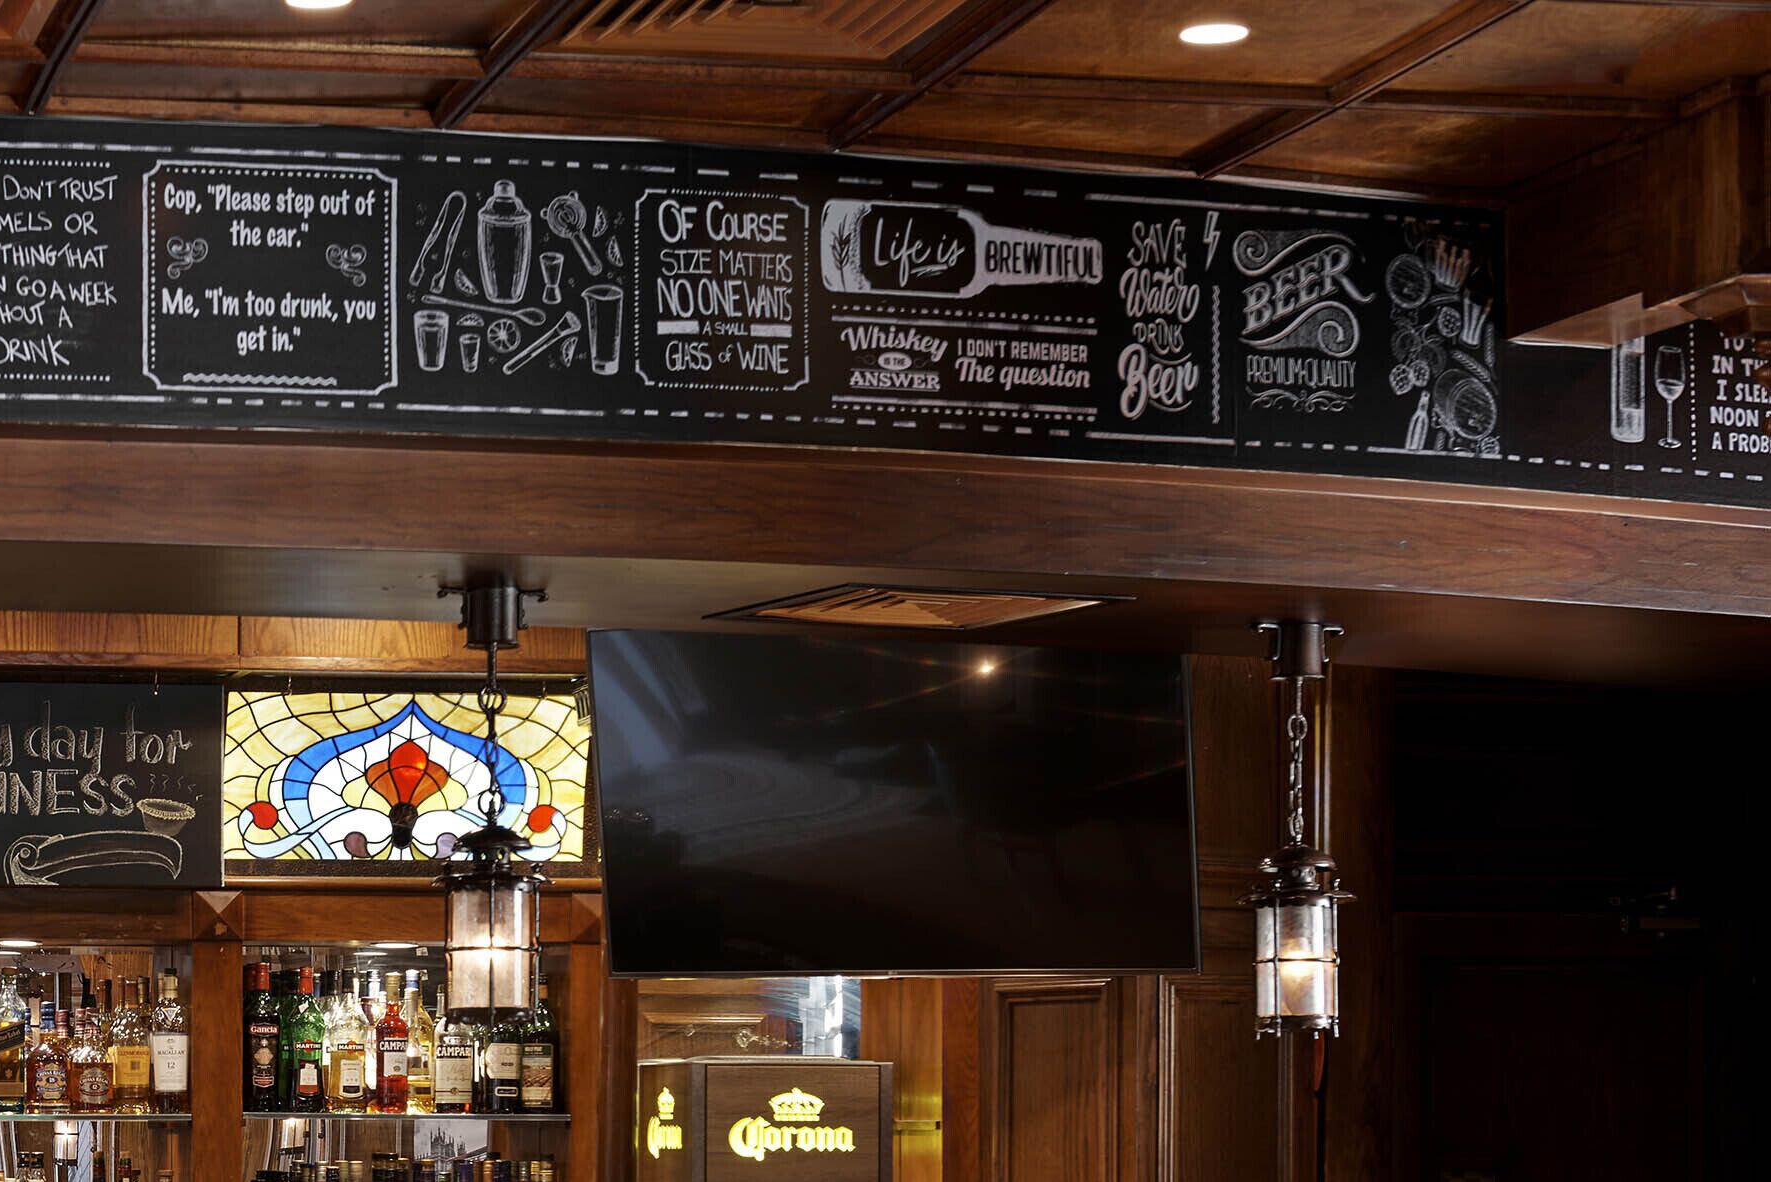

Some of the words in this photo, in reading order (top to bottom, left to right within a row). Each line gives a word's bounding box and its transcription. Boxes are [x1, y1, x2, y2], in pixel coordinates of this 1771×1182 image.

[59, 175, 118, 202] TRUST
[164, 183, 203, 215] Cop,
[276, 187, 315, 218] step
[319, 189, 350, 216] out
[355, 190, 375, 217] of
[64, 211, 98, 235] OR
[229, 219, 261, 247] the
[658, 200, 697, 243] OF
[706, 200, 789, 243] COURSE
[57, 242, 108, 269] THAT
[874, 217, 931, 288] Life
[936, 234, 965, 267] is
[985, 240, 1099, 279] BREWTIFUL
[1128, 218, 1188, 269] SAVE
[660, 249, 712, 277] SIZE
[719, 250, 793, 284] MATTERS
[16, 276, 47, 298] GO
[50, 280, 66, 301] A
[68, 281, 117, 307] WEEK
[161, 287, 200, 319] Me,
[244, 290, 276, 318] too
[280, 292, 339, 323] drunk,
[343, 299, 376, 324] you
[657, 277, 694, 318] NO
[698, 278, 743, 317] ONE
[743, 280, 793, 322] WANTS
[1119, 267, 1200, 325] Water
[1240, 244, 1377, 335] BEER
[59, 306, 73, 329] A
[702, 321, 712, 336] A
[714, 322, 748, 336] SMALL
[236, 325, 267, 356] get
[840, 325, 948, 362] Whiskey
[957, 338, 963, 357] I
[965, 339, 1006, 359] DON'T
[1010, 341, 1089, 363] REMEMBER
[1132, 318, 1185, 356] DRINK
[665, 340, 712, 371] GLASS
[718, 345, 733, 364] of
[737, 342, 789, 374] WINE
[1712, 354, 1734, 375] IN
[850, 371, 941, 390] ANSWER
[954, 357, 993, 383] The
[999, 363, 1091, 392] question
[1118, 343, 1200, 420] Beer
[1716, 379, 1727, 401] I
[1710, 406, 1759, 427] NOON
[1712, 432, 1723, 450] A
[25, 700, 104, 775] day
[118, 704, 193, 765] for
[250, 1025, 278, 1034] Gancia
[728, 1116, 856, 1162] Corona
